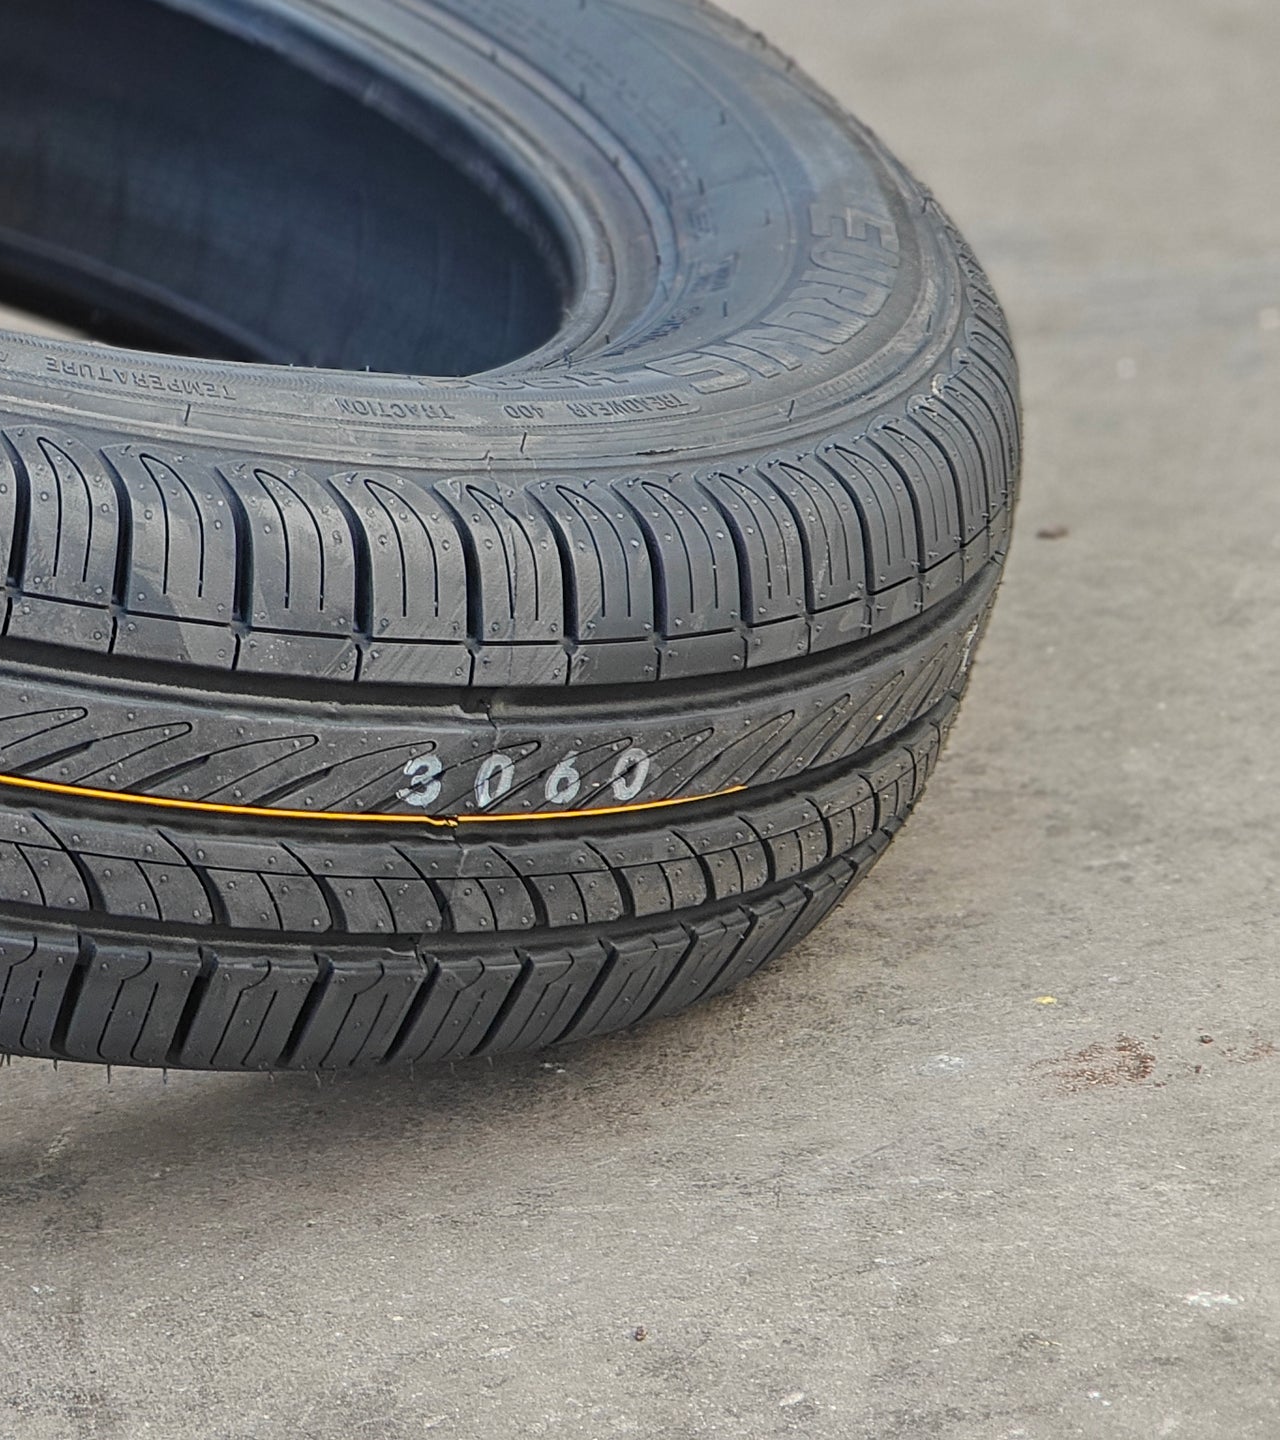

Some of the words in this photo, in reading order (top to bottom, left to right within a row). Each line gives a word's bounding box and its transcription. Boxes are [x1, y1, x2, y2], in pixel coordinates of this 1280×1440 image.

[46, 355, 237, 400] TEMPERATURE
[338, 397, 457, 420] TRACTION
[565, 393, 690, 419] TREADWEAR
[395, 747, 650, 808] 3060
